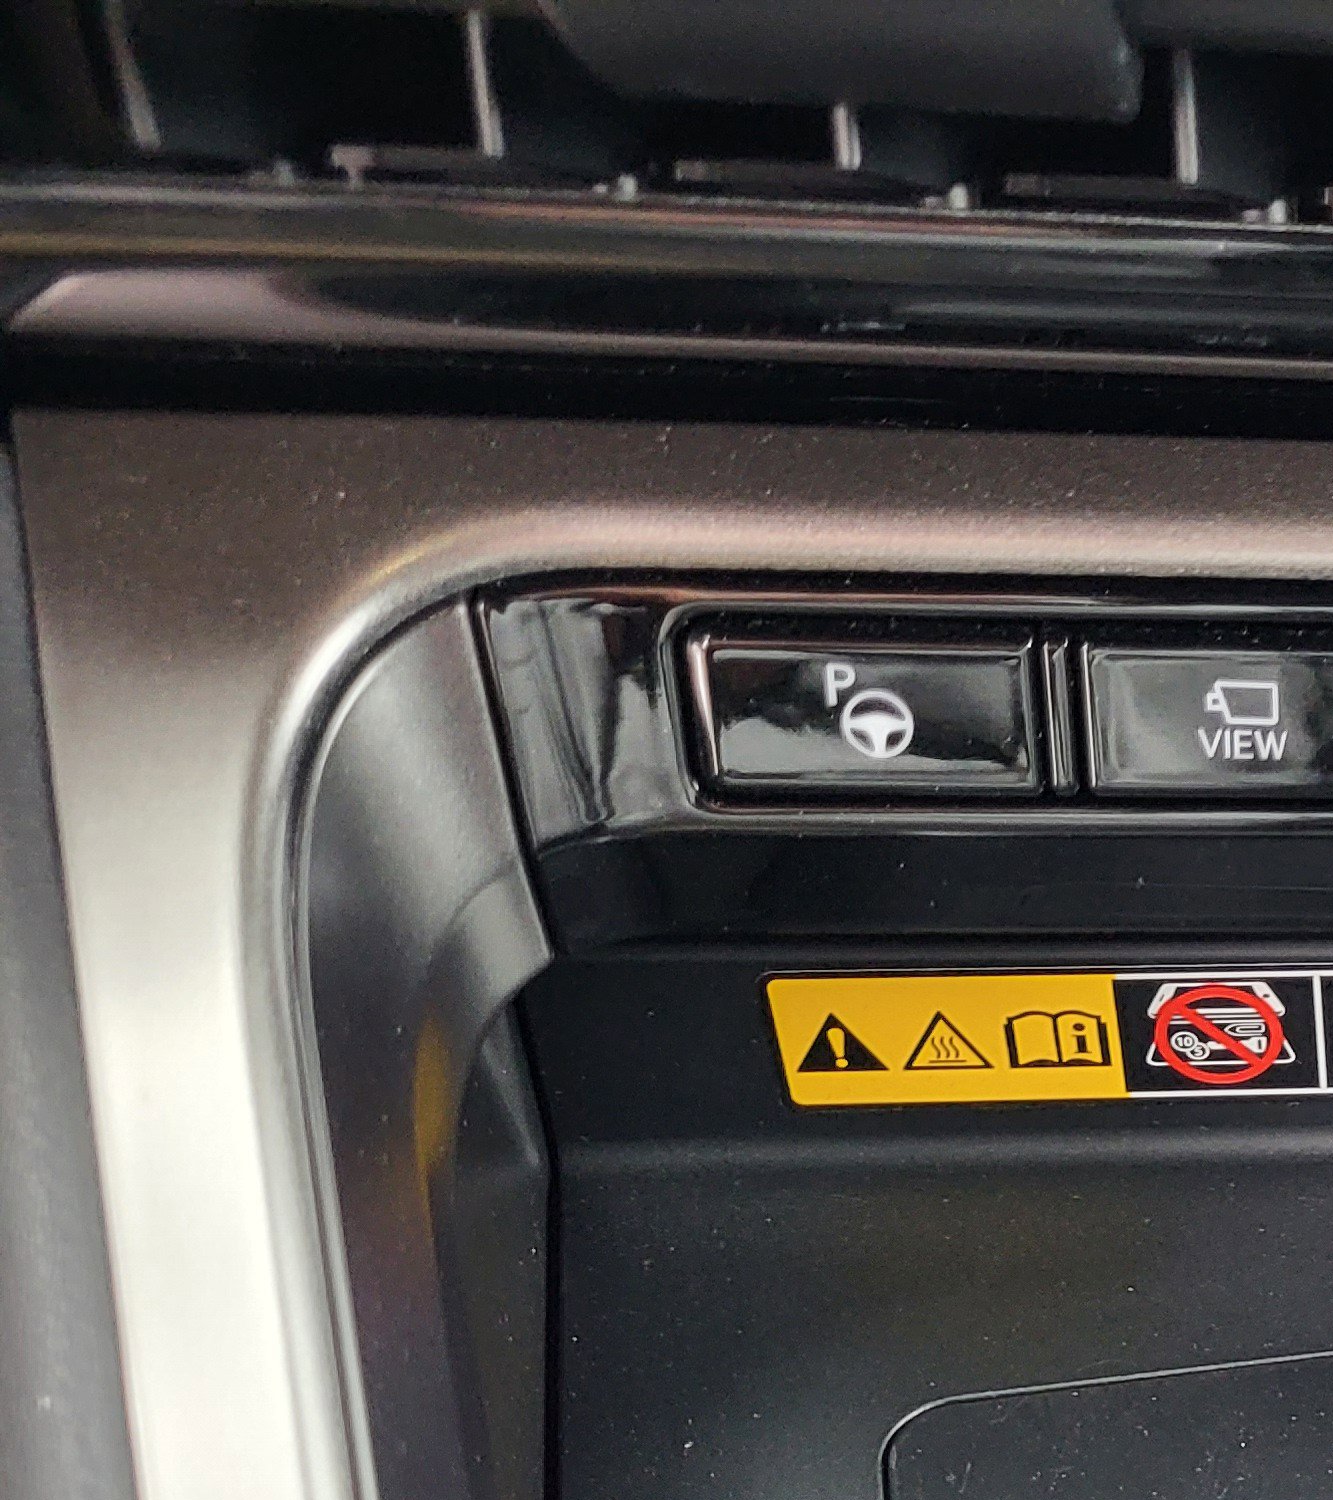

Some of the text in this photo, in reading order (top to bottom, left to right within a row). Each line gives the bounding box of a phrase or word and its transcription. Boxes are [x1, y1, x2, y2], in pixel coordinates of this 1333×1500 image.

[825, 662, 856, 707] P
[1198, 727, 1288, 761] VIEW
[1176, 1035, 1194, 1048] 10
